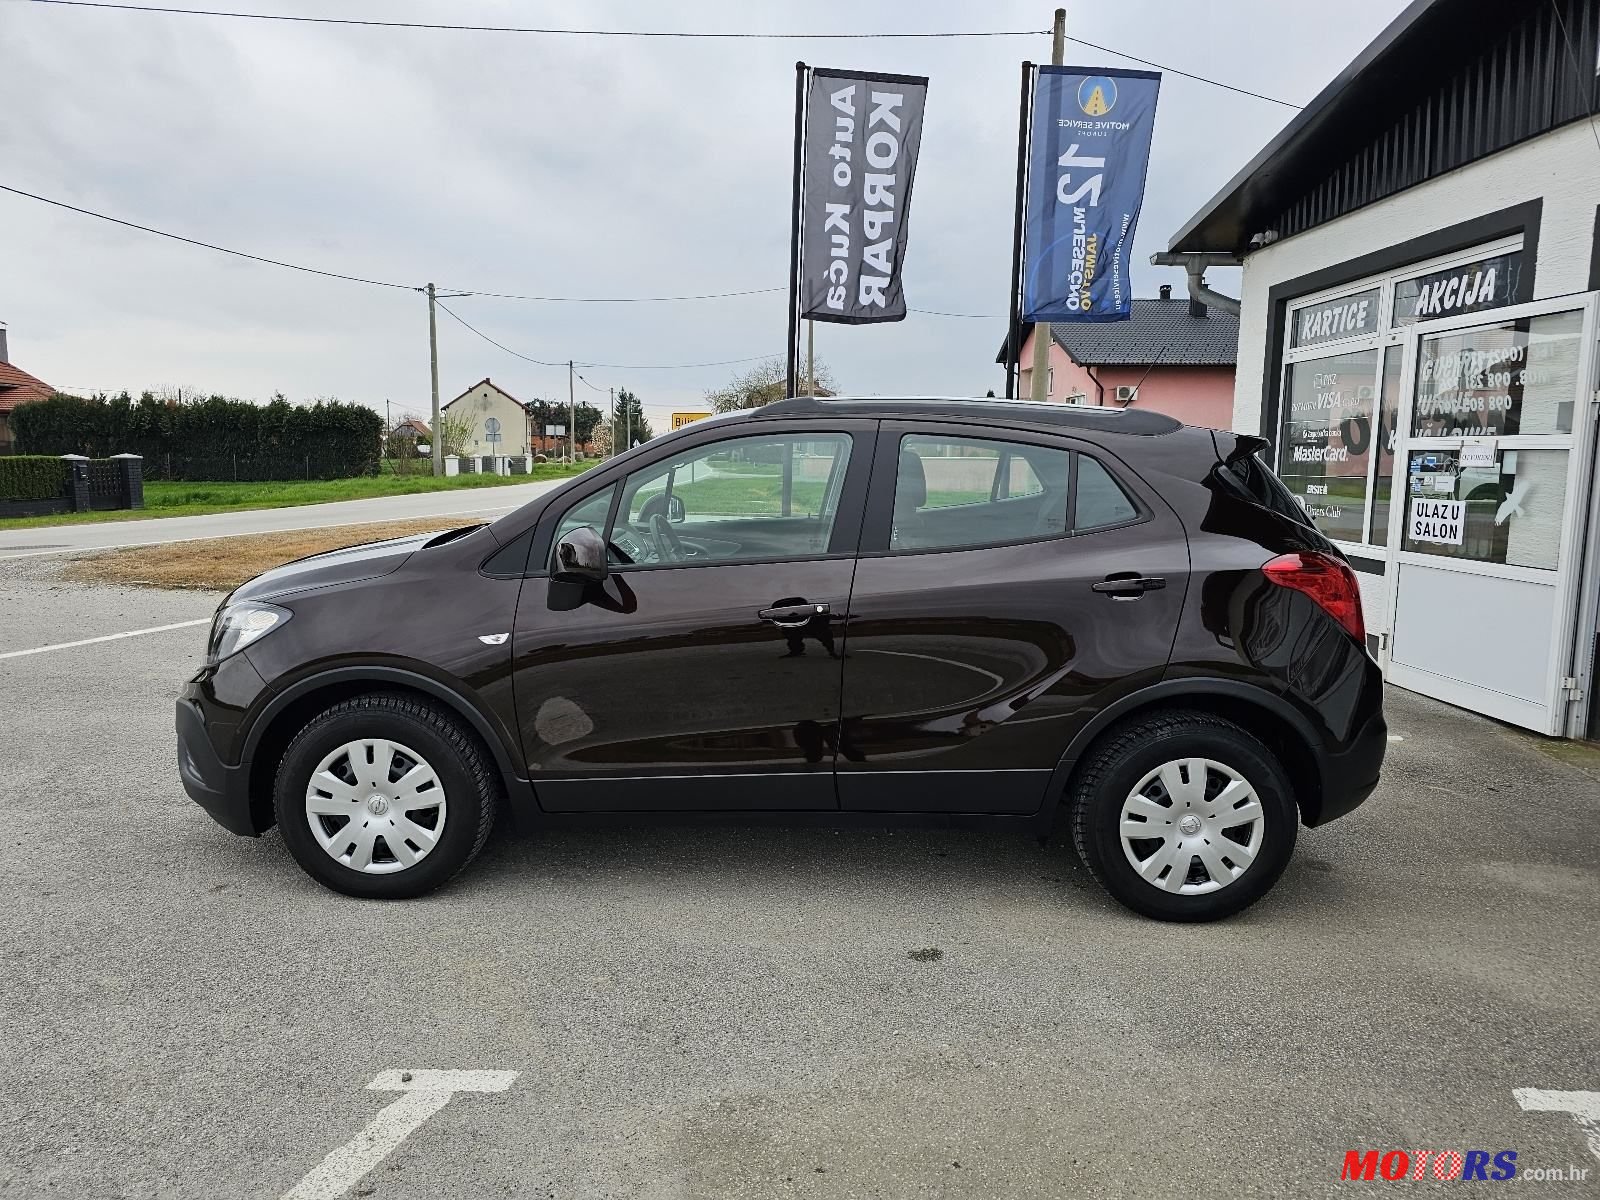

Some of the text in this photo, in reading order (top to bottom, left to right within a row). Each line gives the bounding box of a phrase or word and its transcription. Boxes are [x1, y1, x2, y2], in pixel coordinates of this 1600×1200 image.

[1415, 268, 1496, 315] AKCIJA
[1302, 300, 1369, 340] KARTICE
[1318, 392, 1341, 409] VISA
[1293, 445, 1348, 462] MasterCard
[1416, 502, 1460, 520] ULAZ U
[1415, 520, 1458, 540] SALON
